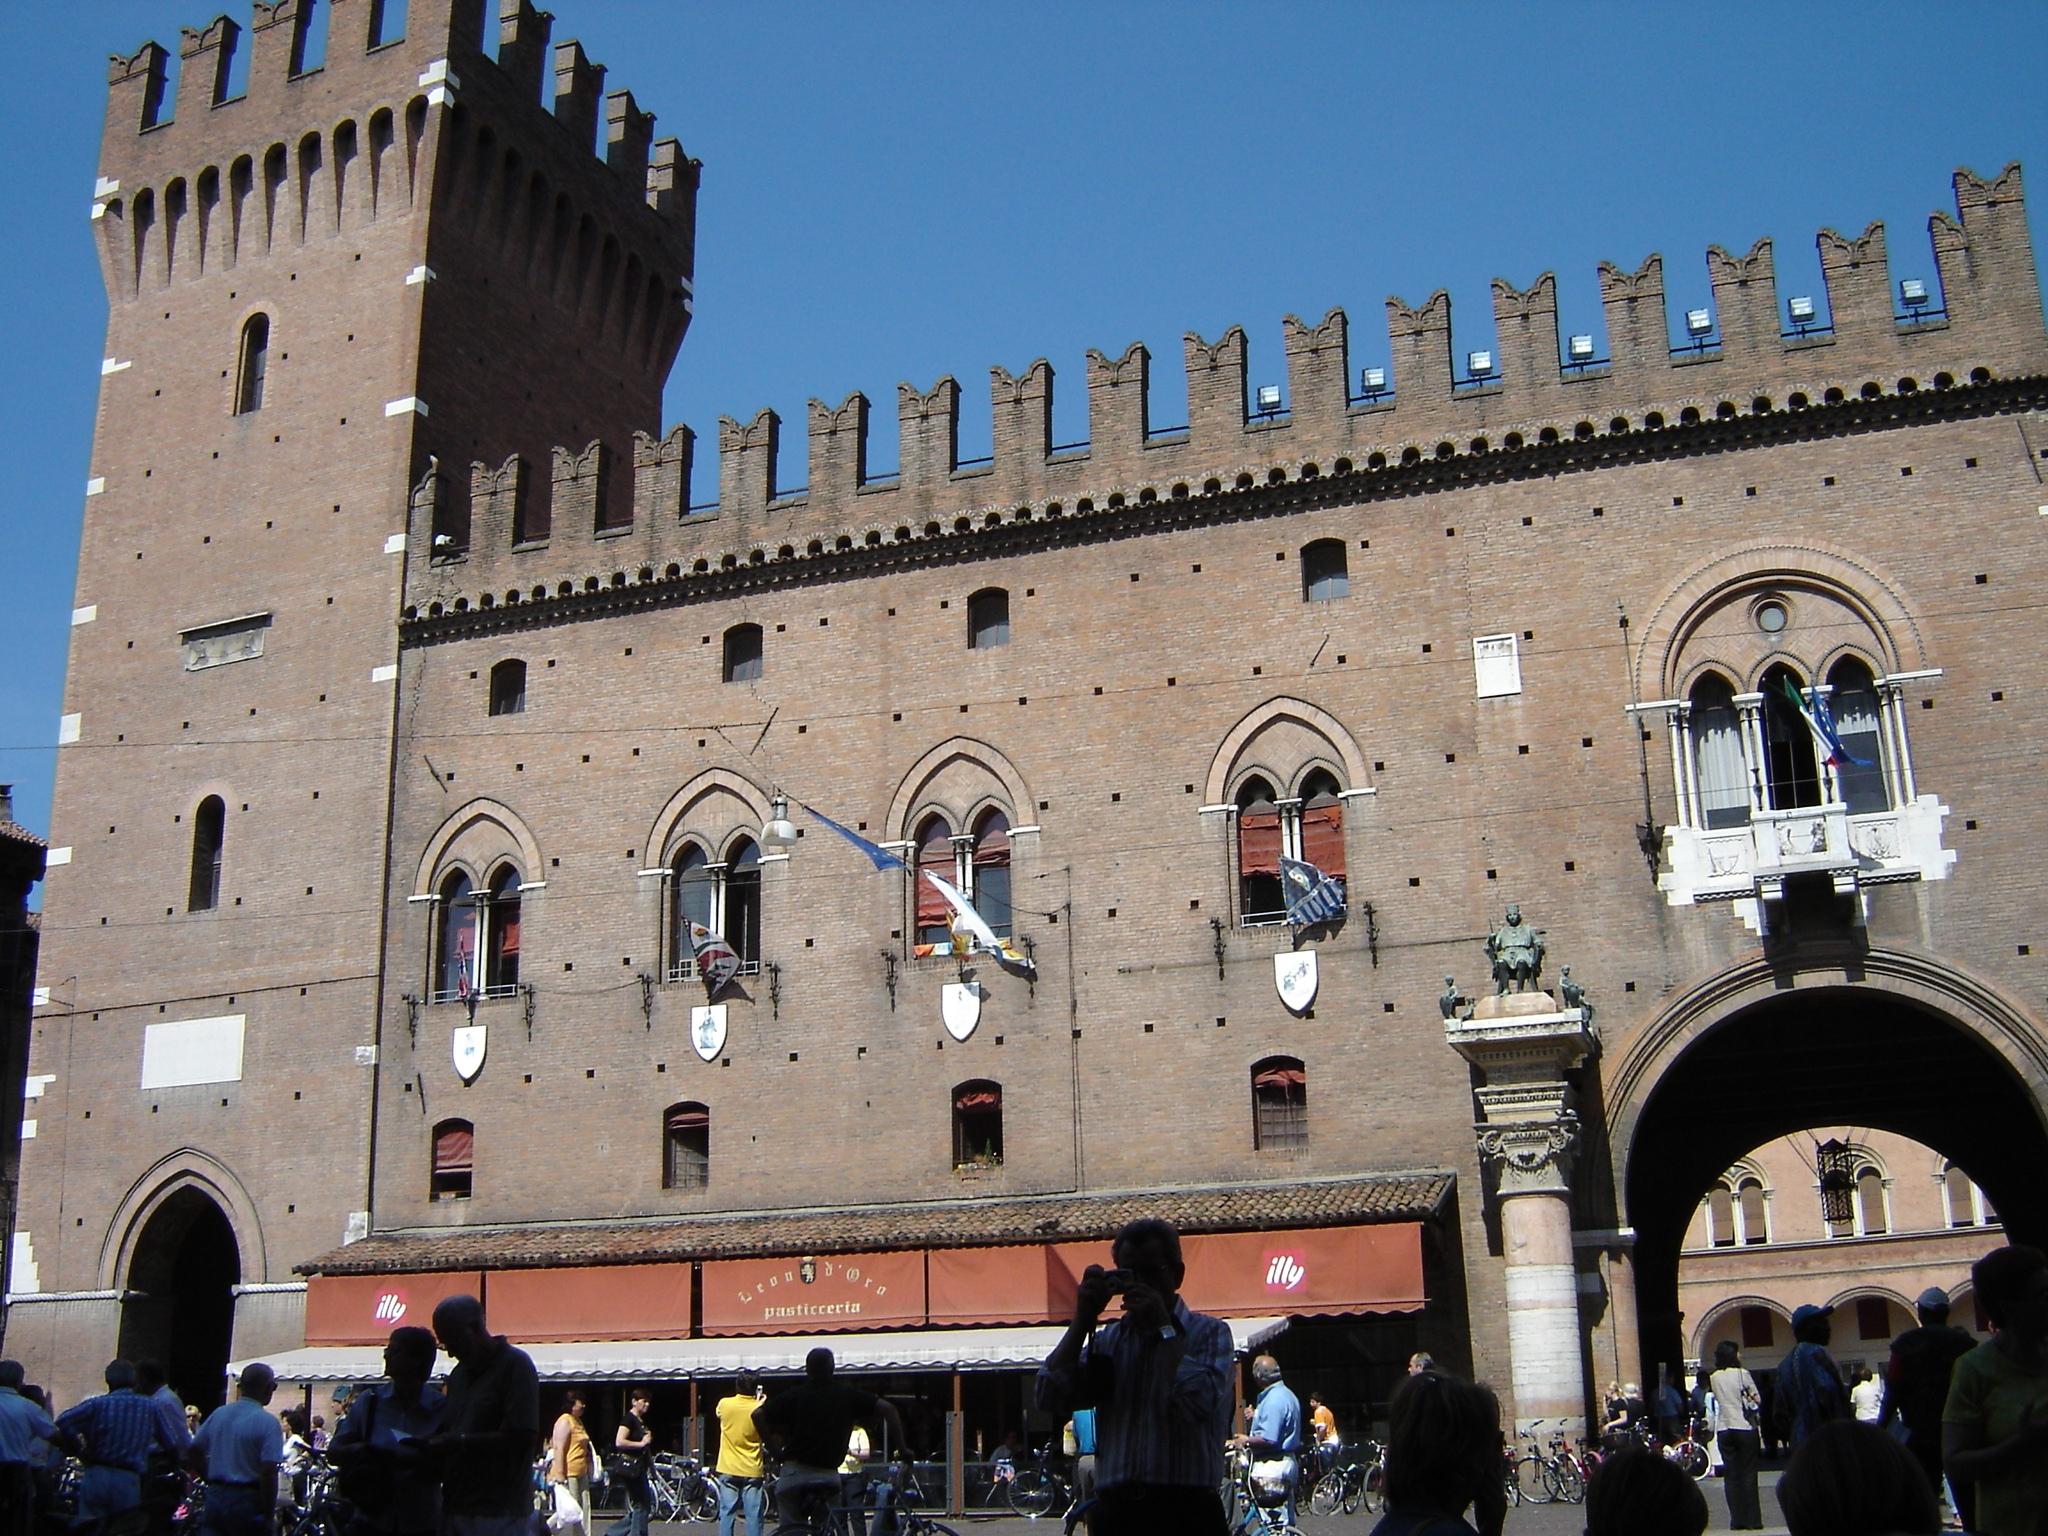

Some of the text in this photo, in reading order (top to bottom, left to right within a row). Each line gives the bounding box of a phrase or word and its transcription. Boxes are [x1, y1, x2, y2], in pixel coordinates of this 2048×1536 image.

[738, 1261, 888, 1304] Leon d'Oro
[1265, 1255, 1305, 1290] illy
[375, 1293, 407, 1324] illy
[764, 1300, 861, 1320] pasticceria
